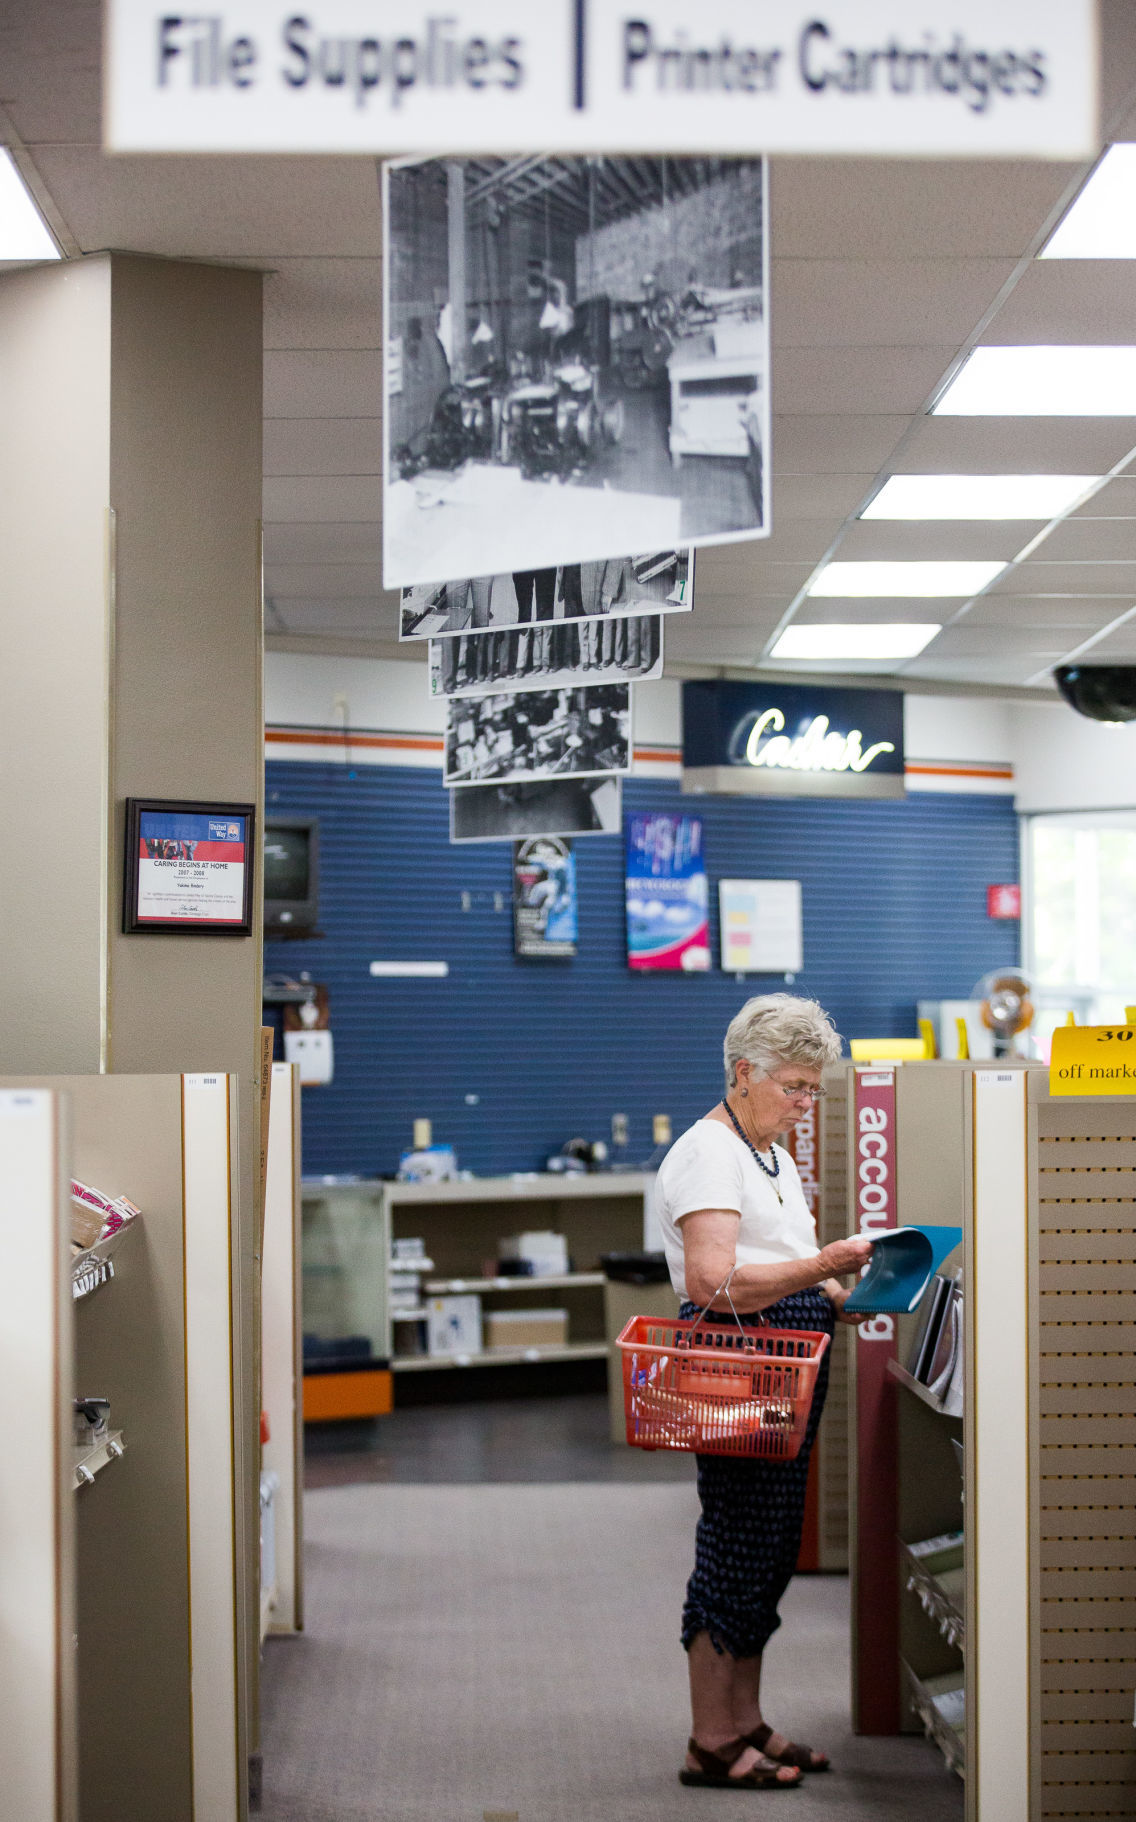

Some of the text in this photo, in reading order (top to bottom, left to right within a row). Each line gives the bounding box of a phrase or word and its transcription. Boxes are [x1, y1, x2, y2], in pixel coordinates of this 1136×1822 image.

[157, 14, 523, 111] File Supplies
[620, 17, 1047, 114] Printer Cartridges
[209, 823, 226, 831] United
[216, 830, 227, 839] Way
[145, 838, 199, 860] WAY
[154, 860, 178, 868] CARING
[178, 861, 201, 869] BEGINS
[1058, 1063, 1086, 1079] off
[858, 1106, 894, 1341] accoug
